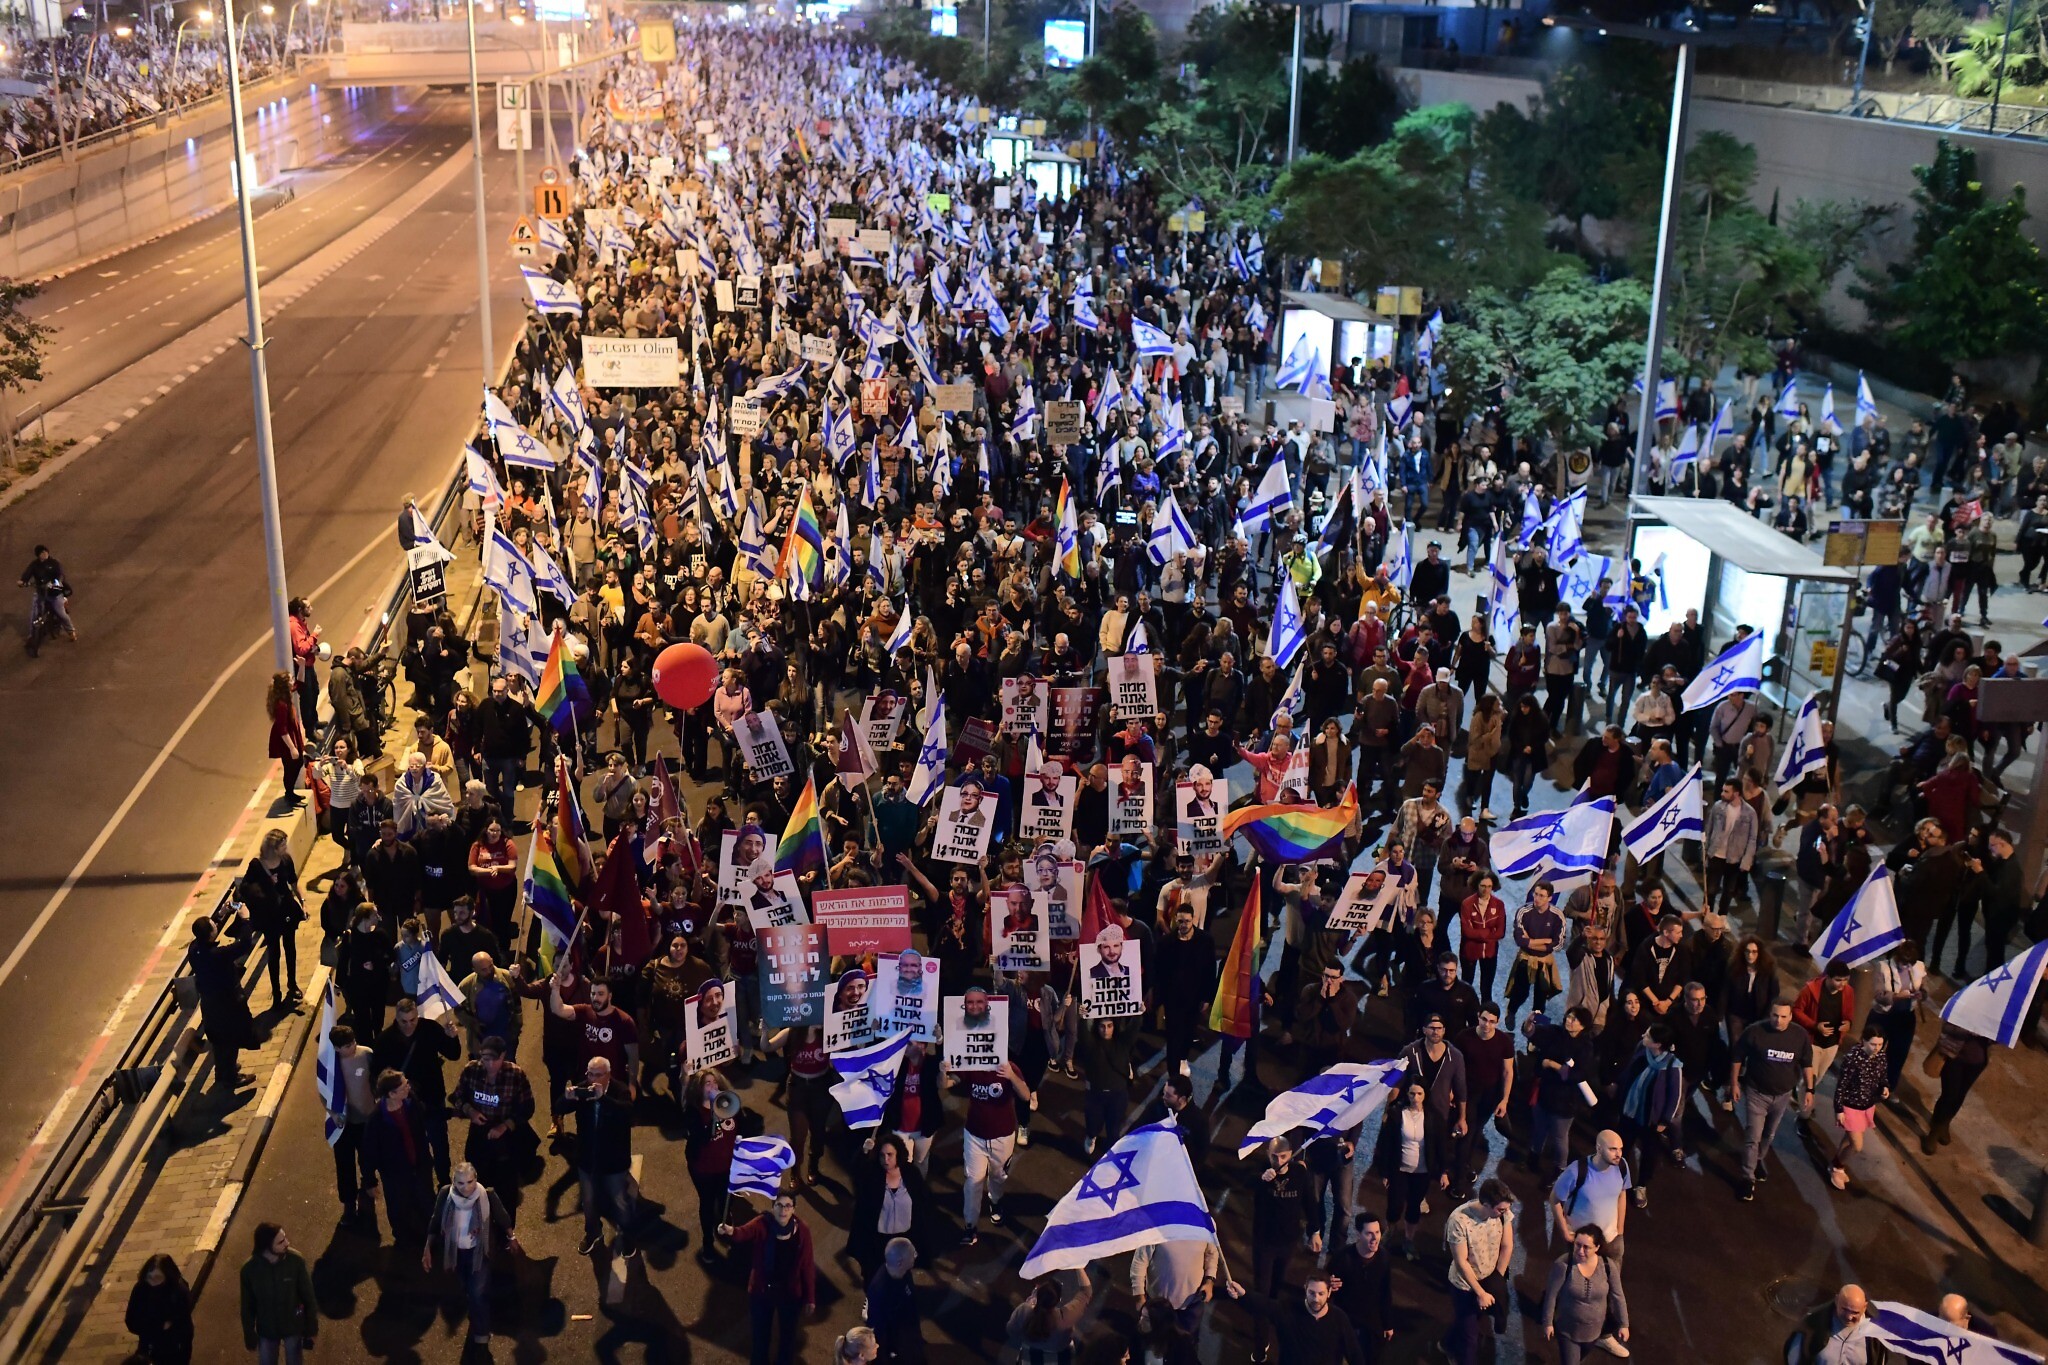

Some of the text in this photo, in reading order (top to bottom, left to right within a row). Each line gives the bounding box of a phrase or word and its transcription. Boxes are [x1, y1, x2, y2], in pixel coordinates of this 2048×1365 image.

[605, 343, 673, 354] LGBT Olim
[1120, 683, 1145, 692] ממה
[1121, 694, 1146, 704] אתה
[752, 740, 776, 756] ממה
[755, 753, 780, 766] אתה
[1124, 798, 1144, 807] ממה
[1039, 809, 1062, 817] ממה
[1124, 808, 1143, 817] אתה
[1038, 818, 1060, 826] אתה
[1194, 818, 1216, 827] ממה
[955, 825, 979, 836] ממה
[1194, 828, 1216, 837] אתה
[953, 836, 976, 846] אתה
[820, 897, 903, 910] מרימות את הראש
[1350, 903, 1373, 911] ממה
[767, 904, 792, 918] ממה
[771, 914, 795, 927] אתה
[873, 917, 905, 925] מרימות
[766, 934, 818, 948] באנו
[1011, 933, 1036, 943] ממה
[1010, 945, 1036, 954] אתה
[768, 952, 819, 968] חושך
[769, 967, 820, 984] לגרש
[1096, 977, 1130, 989] ממה
[1095, 989, 1130, 1002] אתה
[896, 996, 924, 1008] ממה
[1084, 999, 1138, 1017] מפחד?
[843, 1008, 868, 1020] ממה
[895, 1008, 921, 1020] אתה
[842, 1018, 867, 1030] אתה
[704, 1026, 726, 1041] ממה
[967, 1033, 994, 1042] ממה
[704, 1037, 726, 1052] אתה
[967, 1044, 994, 1053] אתה
[972, 1083, 988, 1093] איגי
